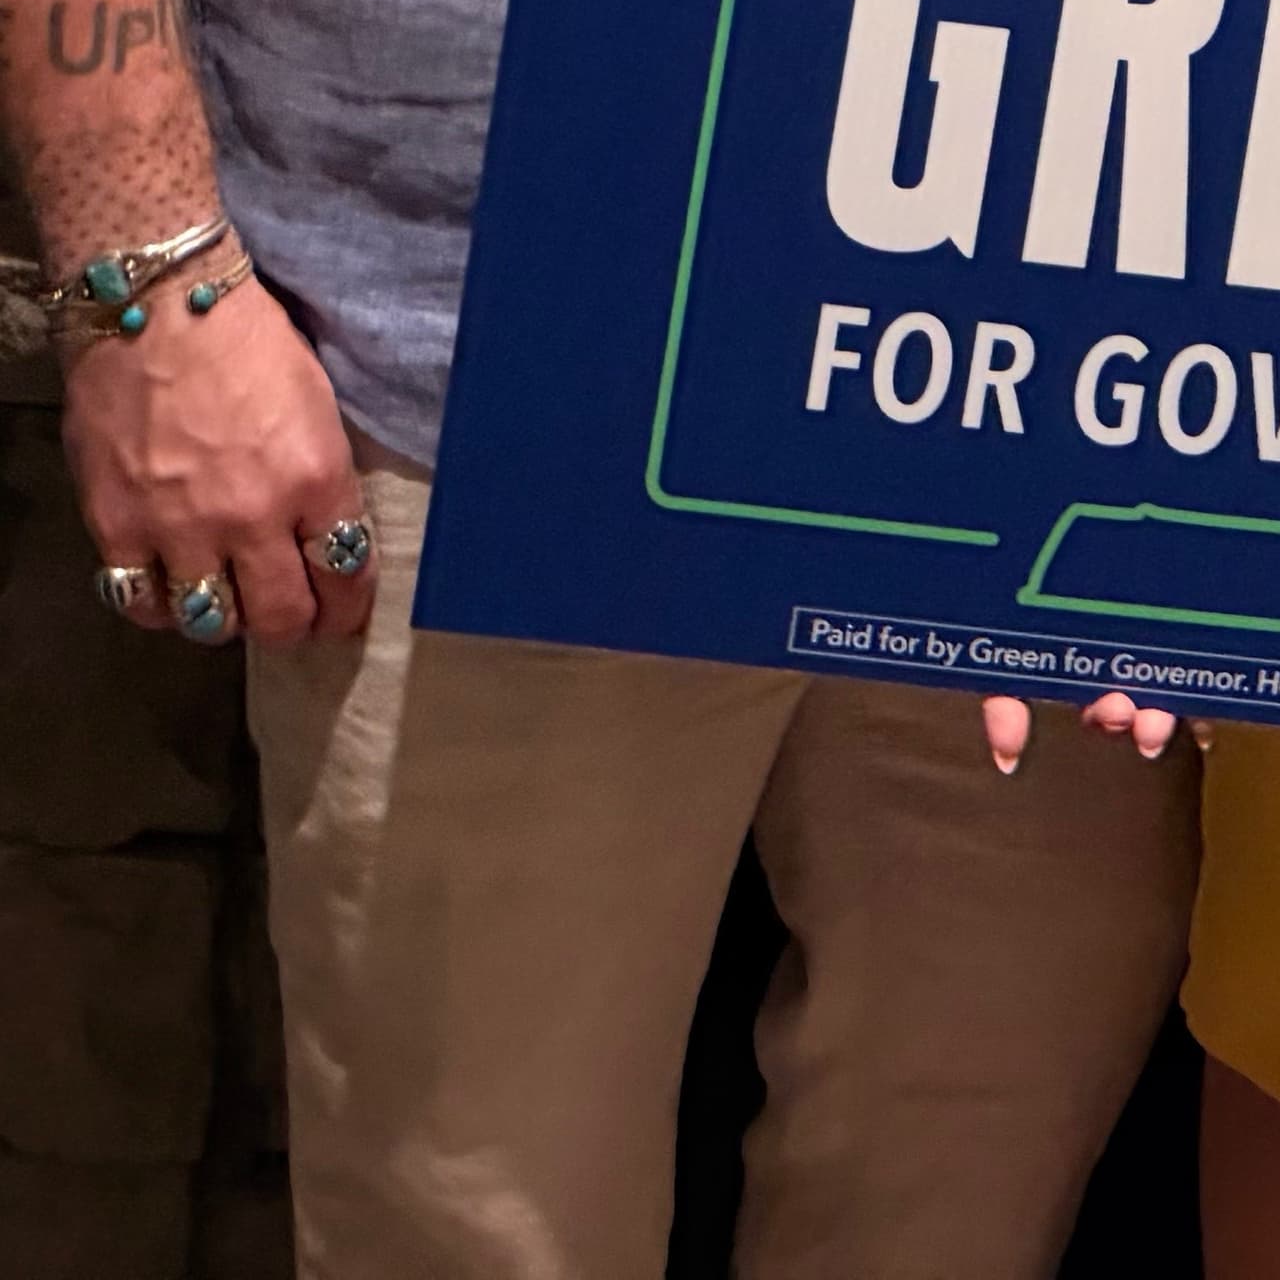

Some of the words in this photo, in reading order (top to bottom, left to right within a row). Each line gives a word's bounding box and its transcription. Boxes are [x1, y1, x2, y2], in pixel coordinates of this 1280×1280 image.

[806, 304, 1035, 434] FOR
[811, 618, 870, 652] Paid
[878, 627, 917, 655] for
[927, 632, 963, 667] by
[969, 637, 1057, 672] Green
[1064, 645, 1104, 677] for
[1111, 653, 1249, 694] Governor.
